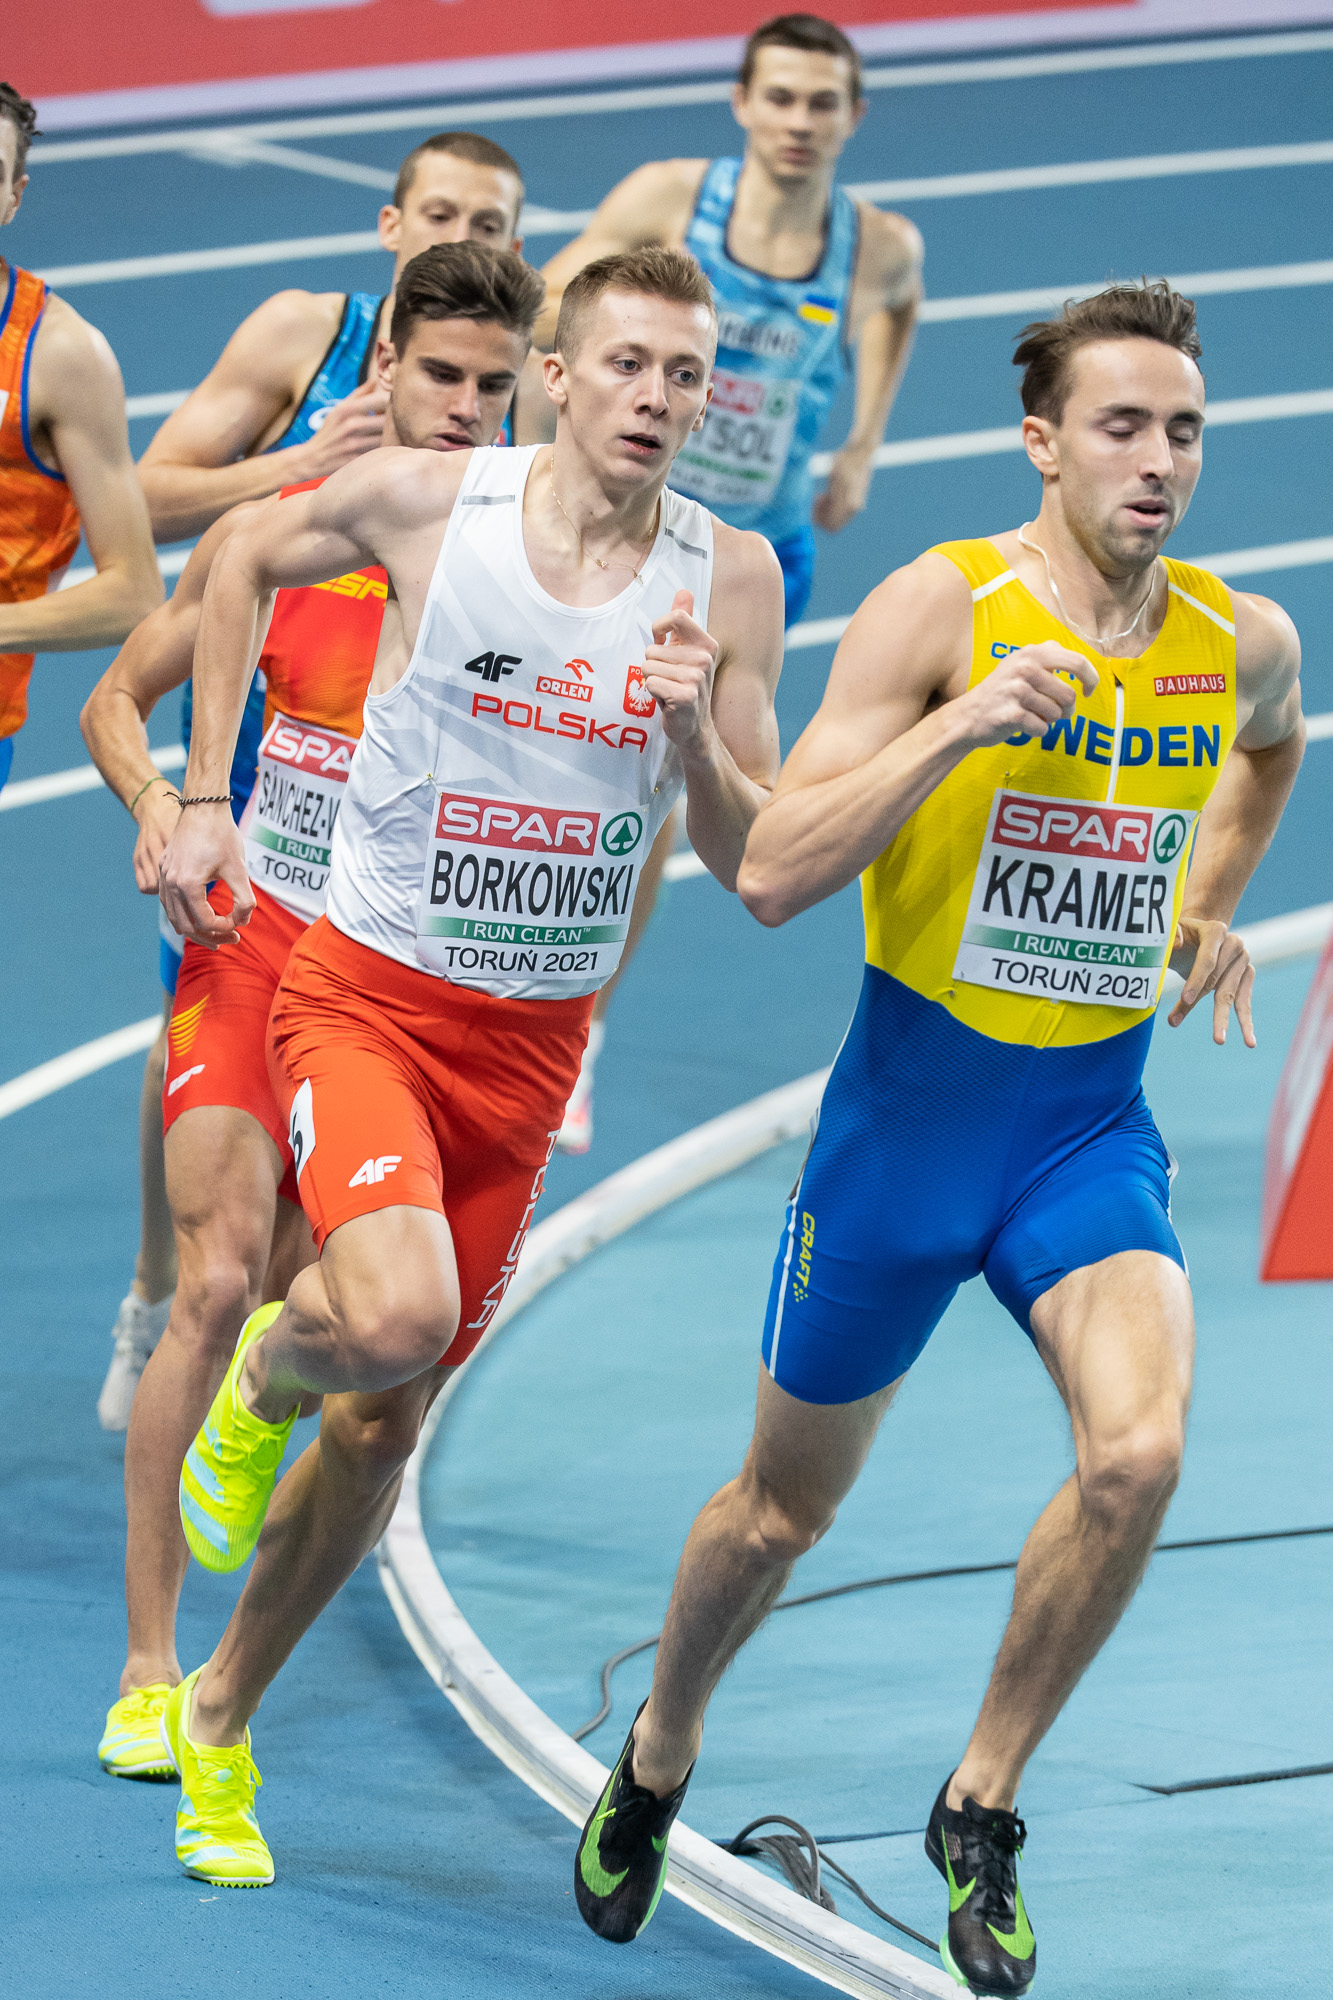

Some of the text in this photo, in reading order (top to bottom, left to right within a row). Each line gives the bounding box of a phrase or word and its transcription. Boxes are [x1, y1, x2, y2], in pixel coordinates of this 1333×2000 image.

[465, 651, 523, 683] 4F
[1154, 674, 1225, 695] BAUHAUS
[539, 679, 590, 700] ORLEN
[471, 692, 649, 754] POLSKA
[441, 801, 595, 850] SPAR
[1000, 804, 1148, 856] SPAR
[276, 837, 283, 851] I
[286, 841, 323, 861] RUN
[262, 855, 331, 891] TORU
[429, 849, 636, 919] BORKOWSKI
[982, 855, 1168, 935] KRAMER
[462, 922, 469, 937] I
[473, 924, 516, 941] RUN
[1013, 933, 1022, 950] I
[1024, 935, 1069, 957] RUN
[444, 946, 598, 973] TORUŃ 2021
[991, 957, 1150, 1001] TORUŃ 2021
[348, 1154, 403, 1189] 4F
[796, 1211, 816, 1288] CRAFT
